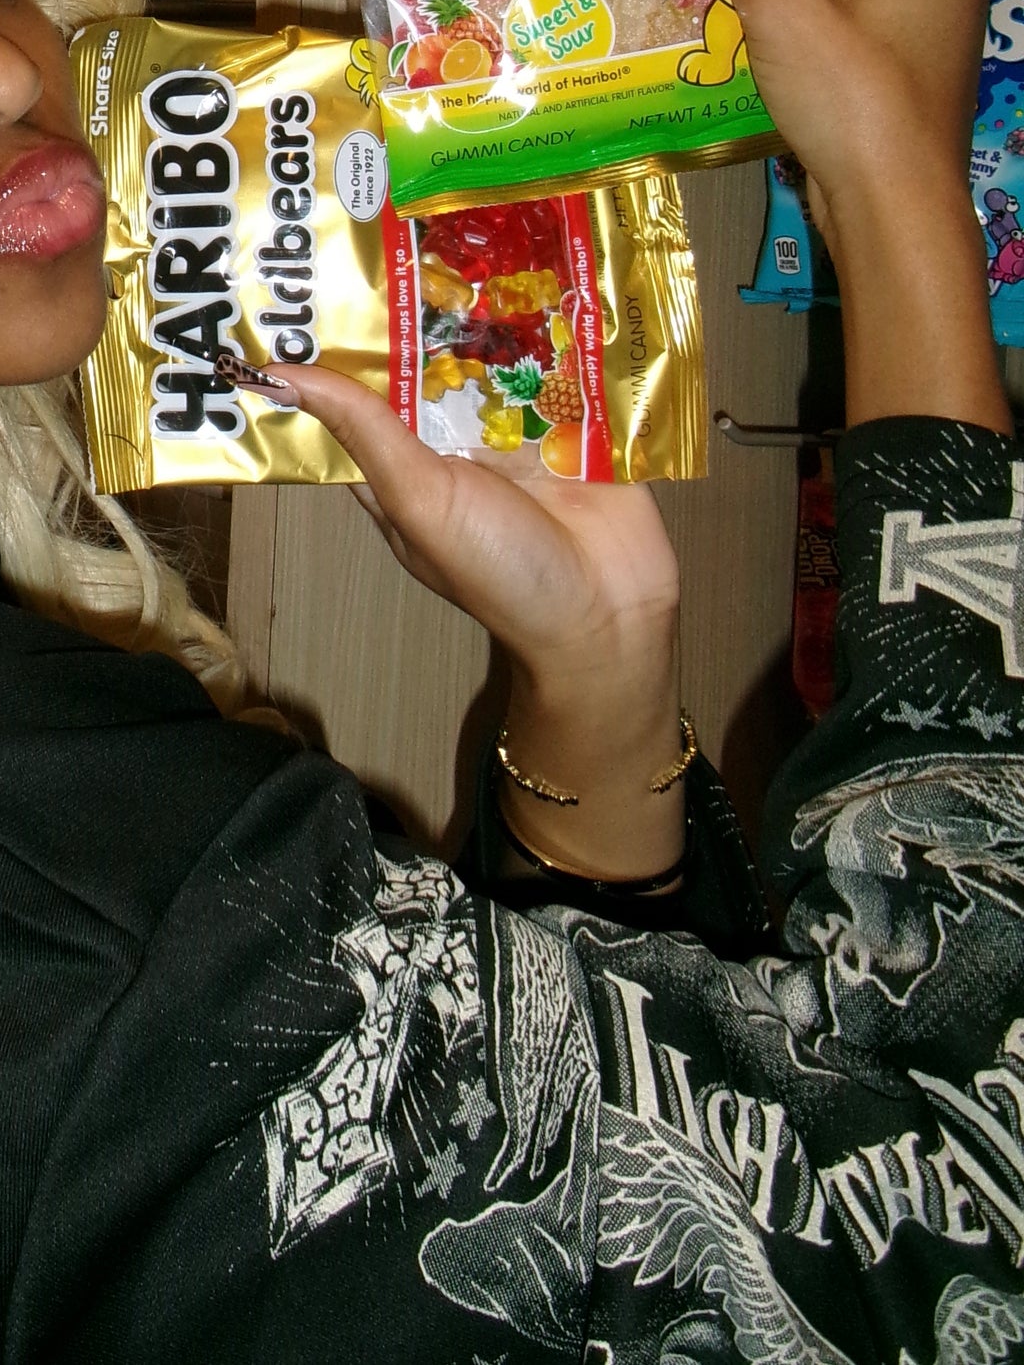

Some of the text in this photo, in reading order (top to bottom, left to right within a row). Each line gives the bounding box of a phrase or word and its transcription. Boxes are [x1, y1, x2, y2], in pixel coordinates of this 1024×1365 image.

[545, 22, 594, 59] Sour
[90, 65, 113, 136] Share
[442, 95, 463, 109] the
[556, 76, 568, 90] of
[499, 84, 676, 122] NATUAL AND ARTIFICIAL FRUIT FLAVORS
[629, 92, 762, 130] NET WT 4.5 OZ
[431, 129, 576, 168] GUMMI CANDY
[990, 151, 1002, 163] &
[349, 142, 363, 210] The Original
[365, 148, 374, 206] since 1922
[149, 74, 238, 434] HARIBO
[259, 94, 316, 384] oldbears
[396, 248, 406, 264] so
[775, 240, 797, 258] 100
[395, 265, 407, 277] it
[396, 279, 409, 308] love
[399, 310, 413, 377] grown-ups
[582, 314, 596, 351] world
[624, 294, 647, 362] CANDY
[398, 380, 410, 405] and
[585, 354, 599, 396] happy
[593, 399, 604, 422] the
[807, 534, 839, 576] DROP
